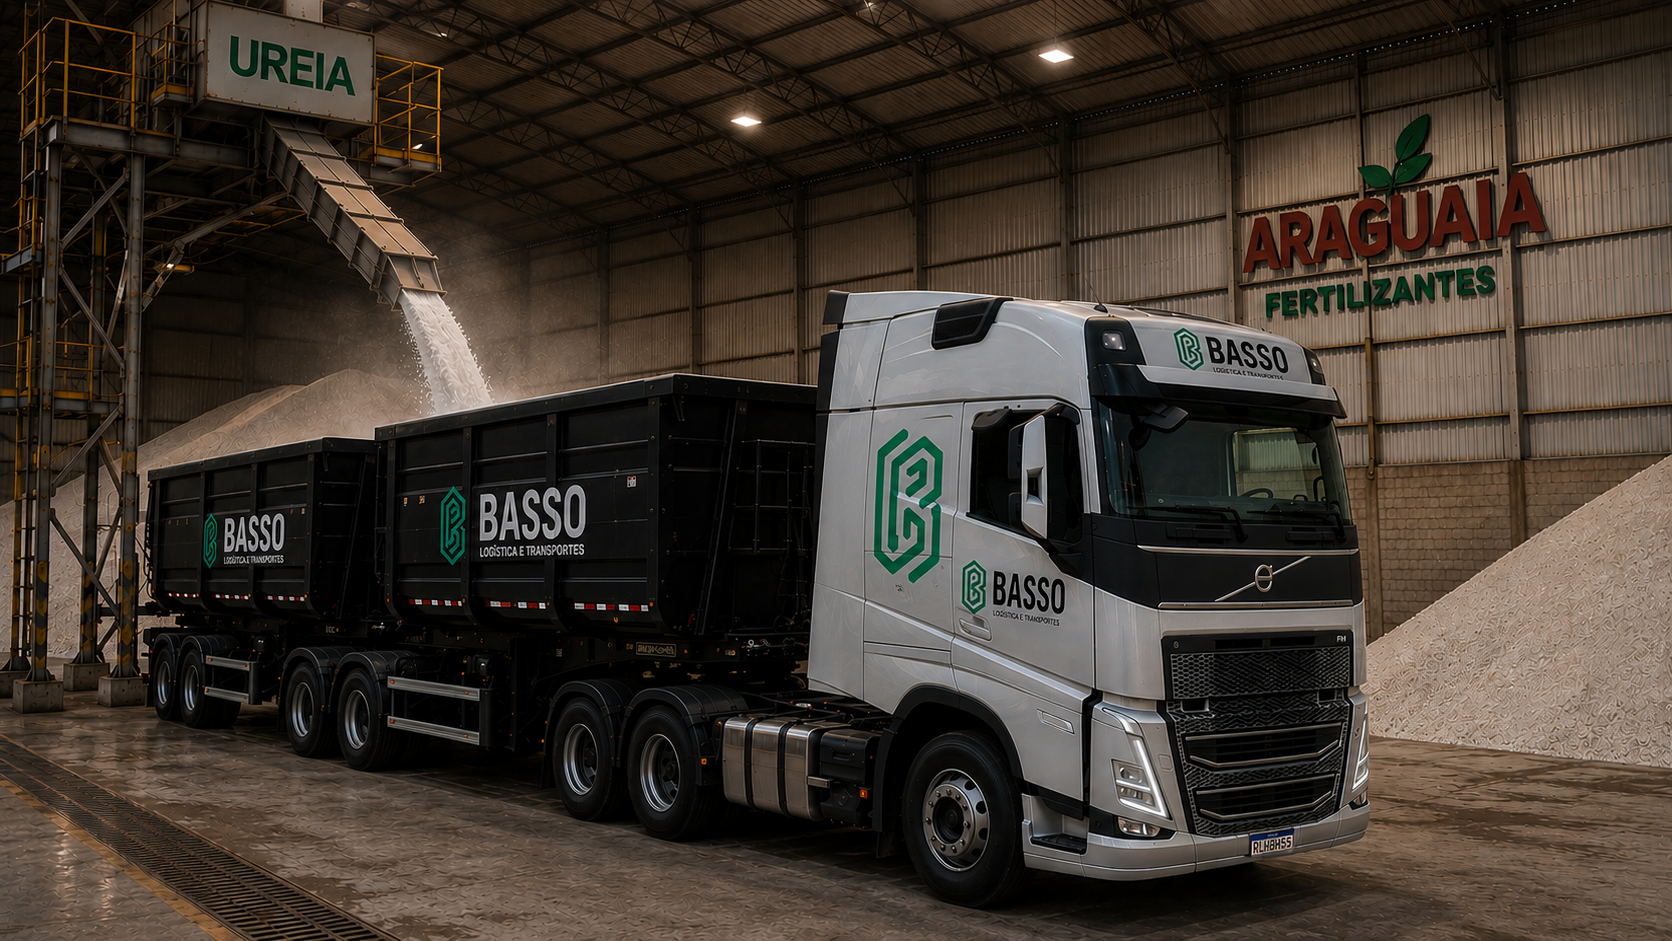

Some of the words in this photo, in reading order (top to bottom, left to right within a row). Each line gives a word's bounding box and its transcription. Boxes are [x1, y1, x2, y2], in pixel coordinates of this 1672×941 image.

[230, 35, 356, 96] UREIA
[1242, 171, 1547, 273] ARAGUAIA
[1265, 265, 1496, 318] FERTILIZANTES
[1205, 336, 1289, 374] BASSO
[223, 512, 285, 553] BASSO
[479, 484, 586, 542] BASSO
[519, 546, 524, 557] E
[525, 544, 585, 556] TRANSPORTES
[993, 570, 1066, 614] BASSO
[1019, 613, 1024, 621] E
